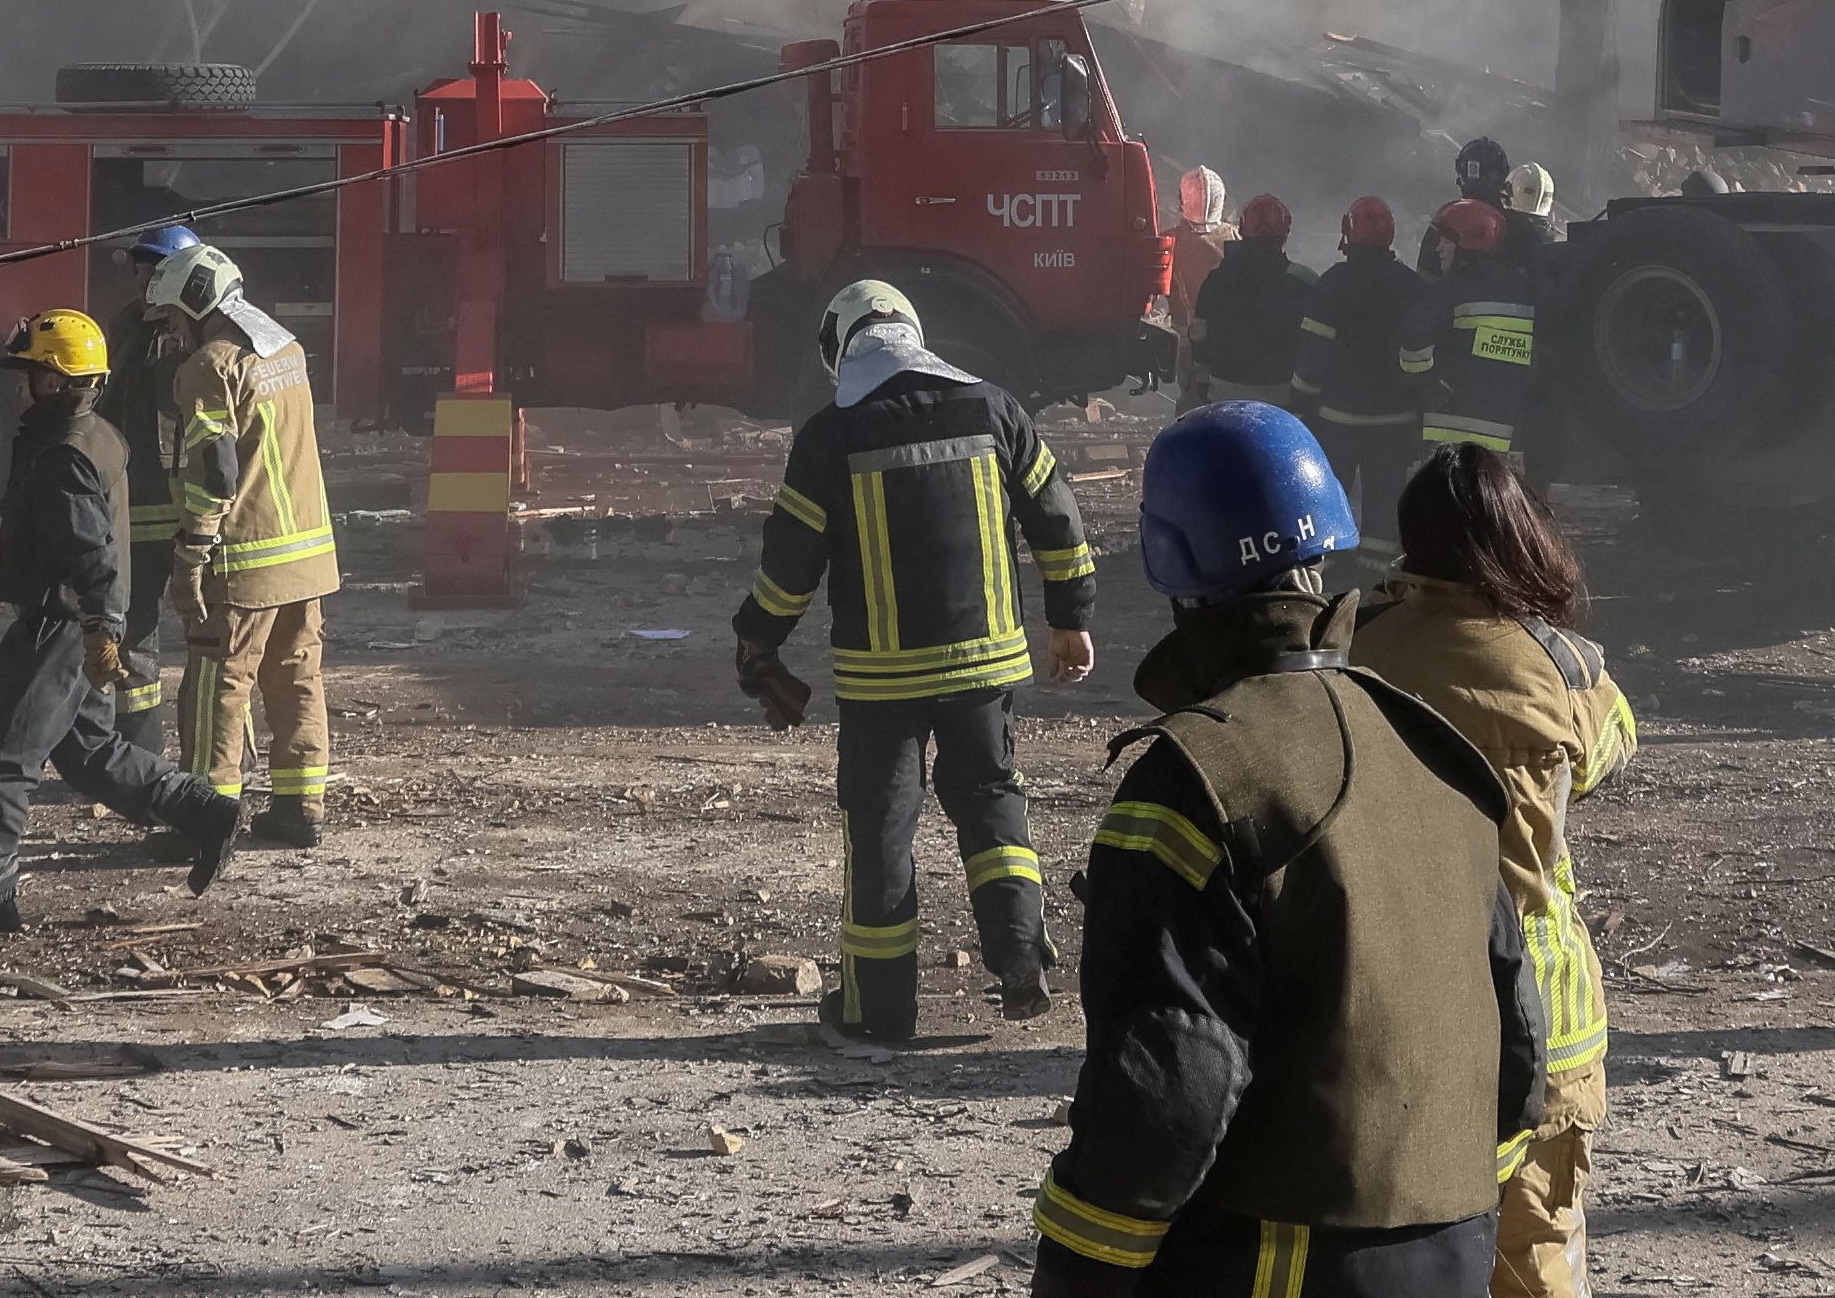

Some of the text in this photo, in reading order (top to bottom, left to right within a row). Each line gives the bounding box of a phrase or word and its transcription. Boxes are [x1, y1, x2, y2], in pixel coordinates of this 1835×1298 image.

[987, 193, 1081, 228] ЧСПТ
[1033, 249, 1076, 268] КИЇВ
[1490, 334, 1527, 349] СЛУЖБА
